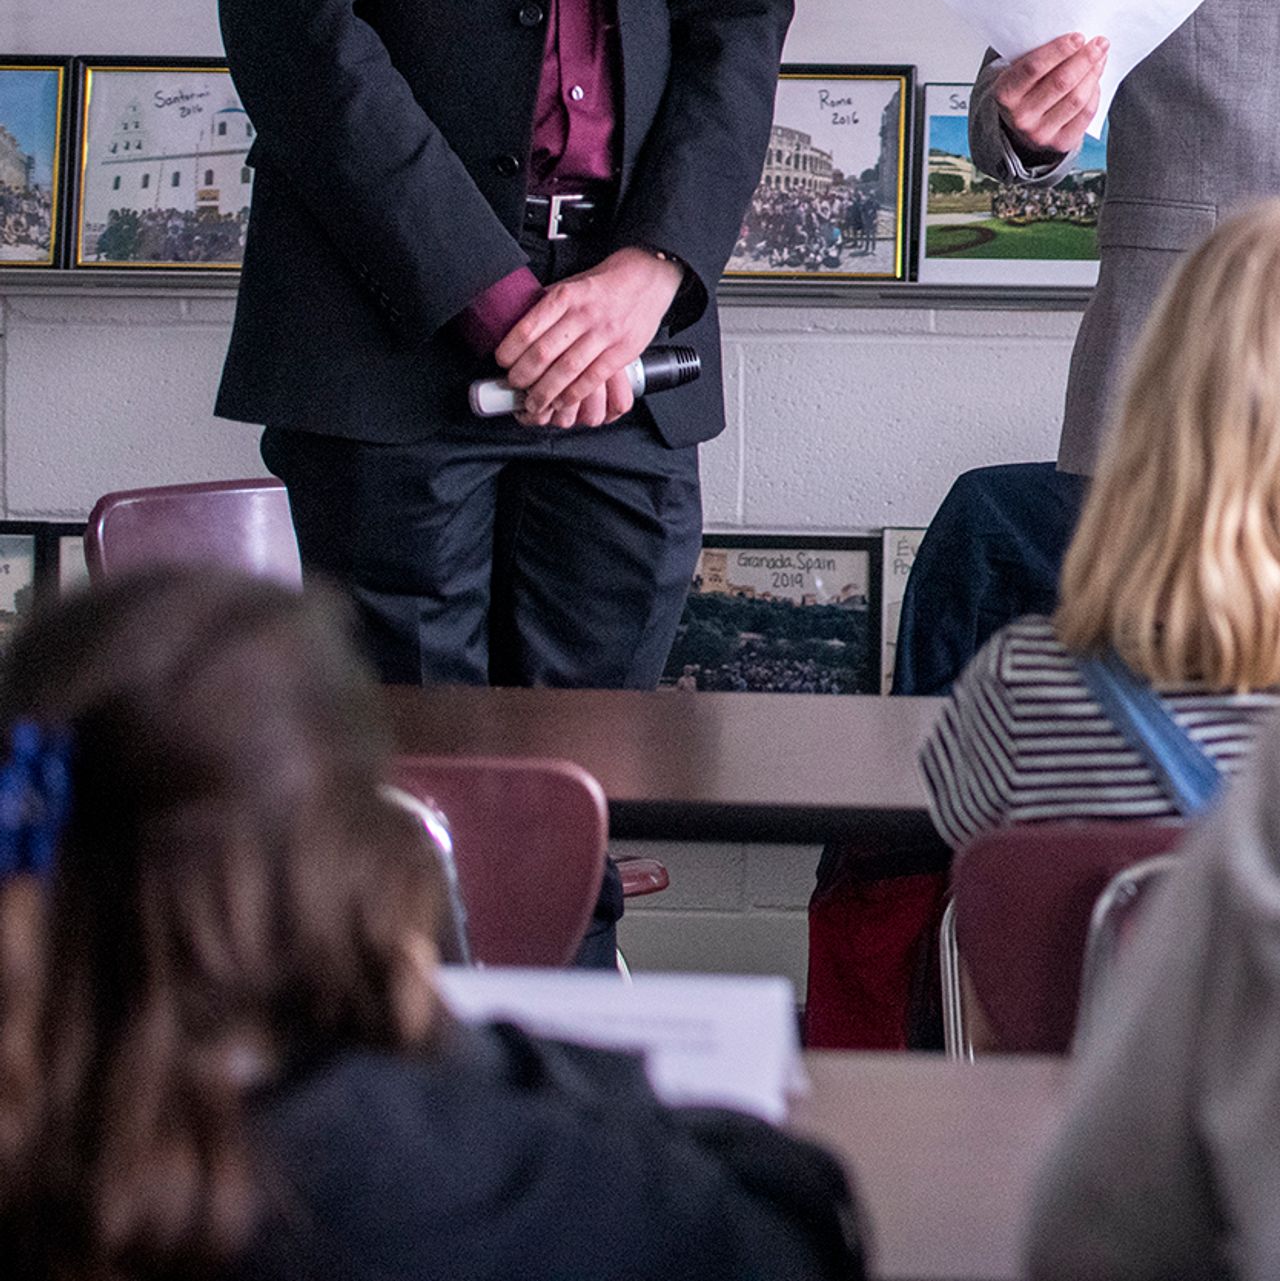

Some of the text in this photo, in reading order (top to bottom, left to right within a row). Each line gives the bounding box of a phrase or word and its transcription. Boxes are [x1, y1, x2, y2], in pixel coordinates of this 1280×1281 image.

[832, 111, 860, 125] 2016
[796, 552, 836, 574] Spain
[772, 572, 804, 588] 2019
